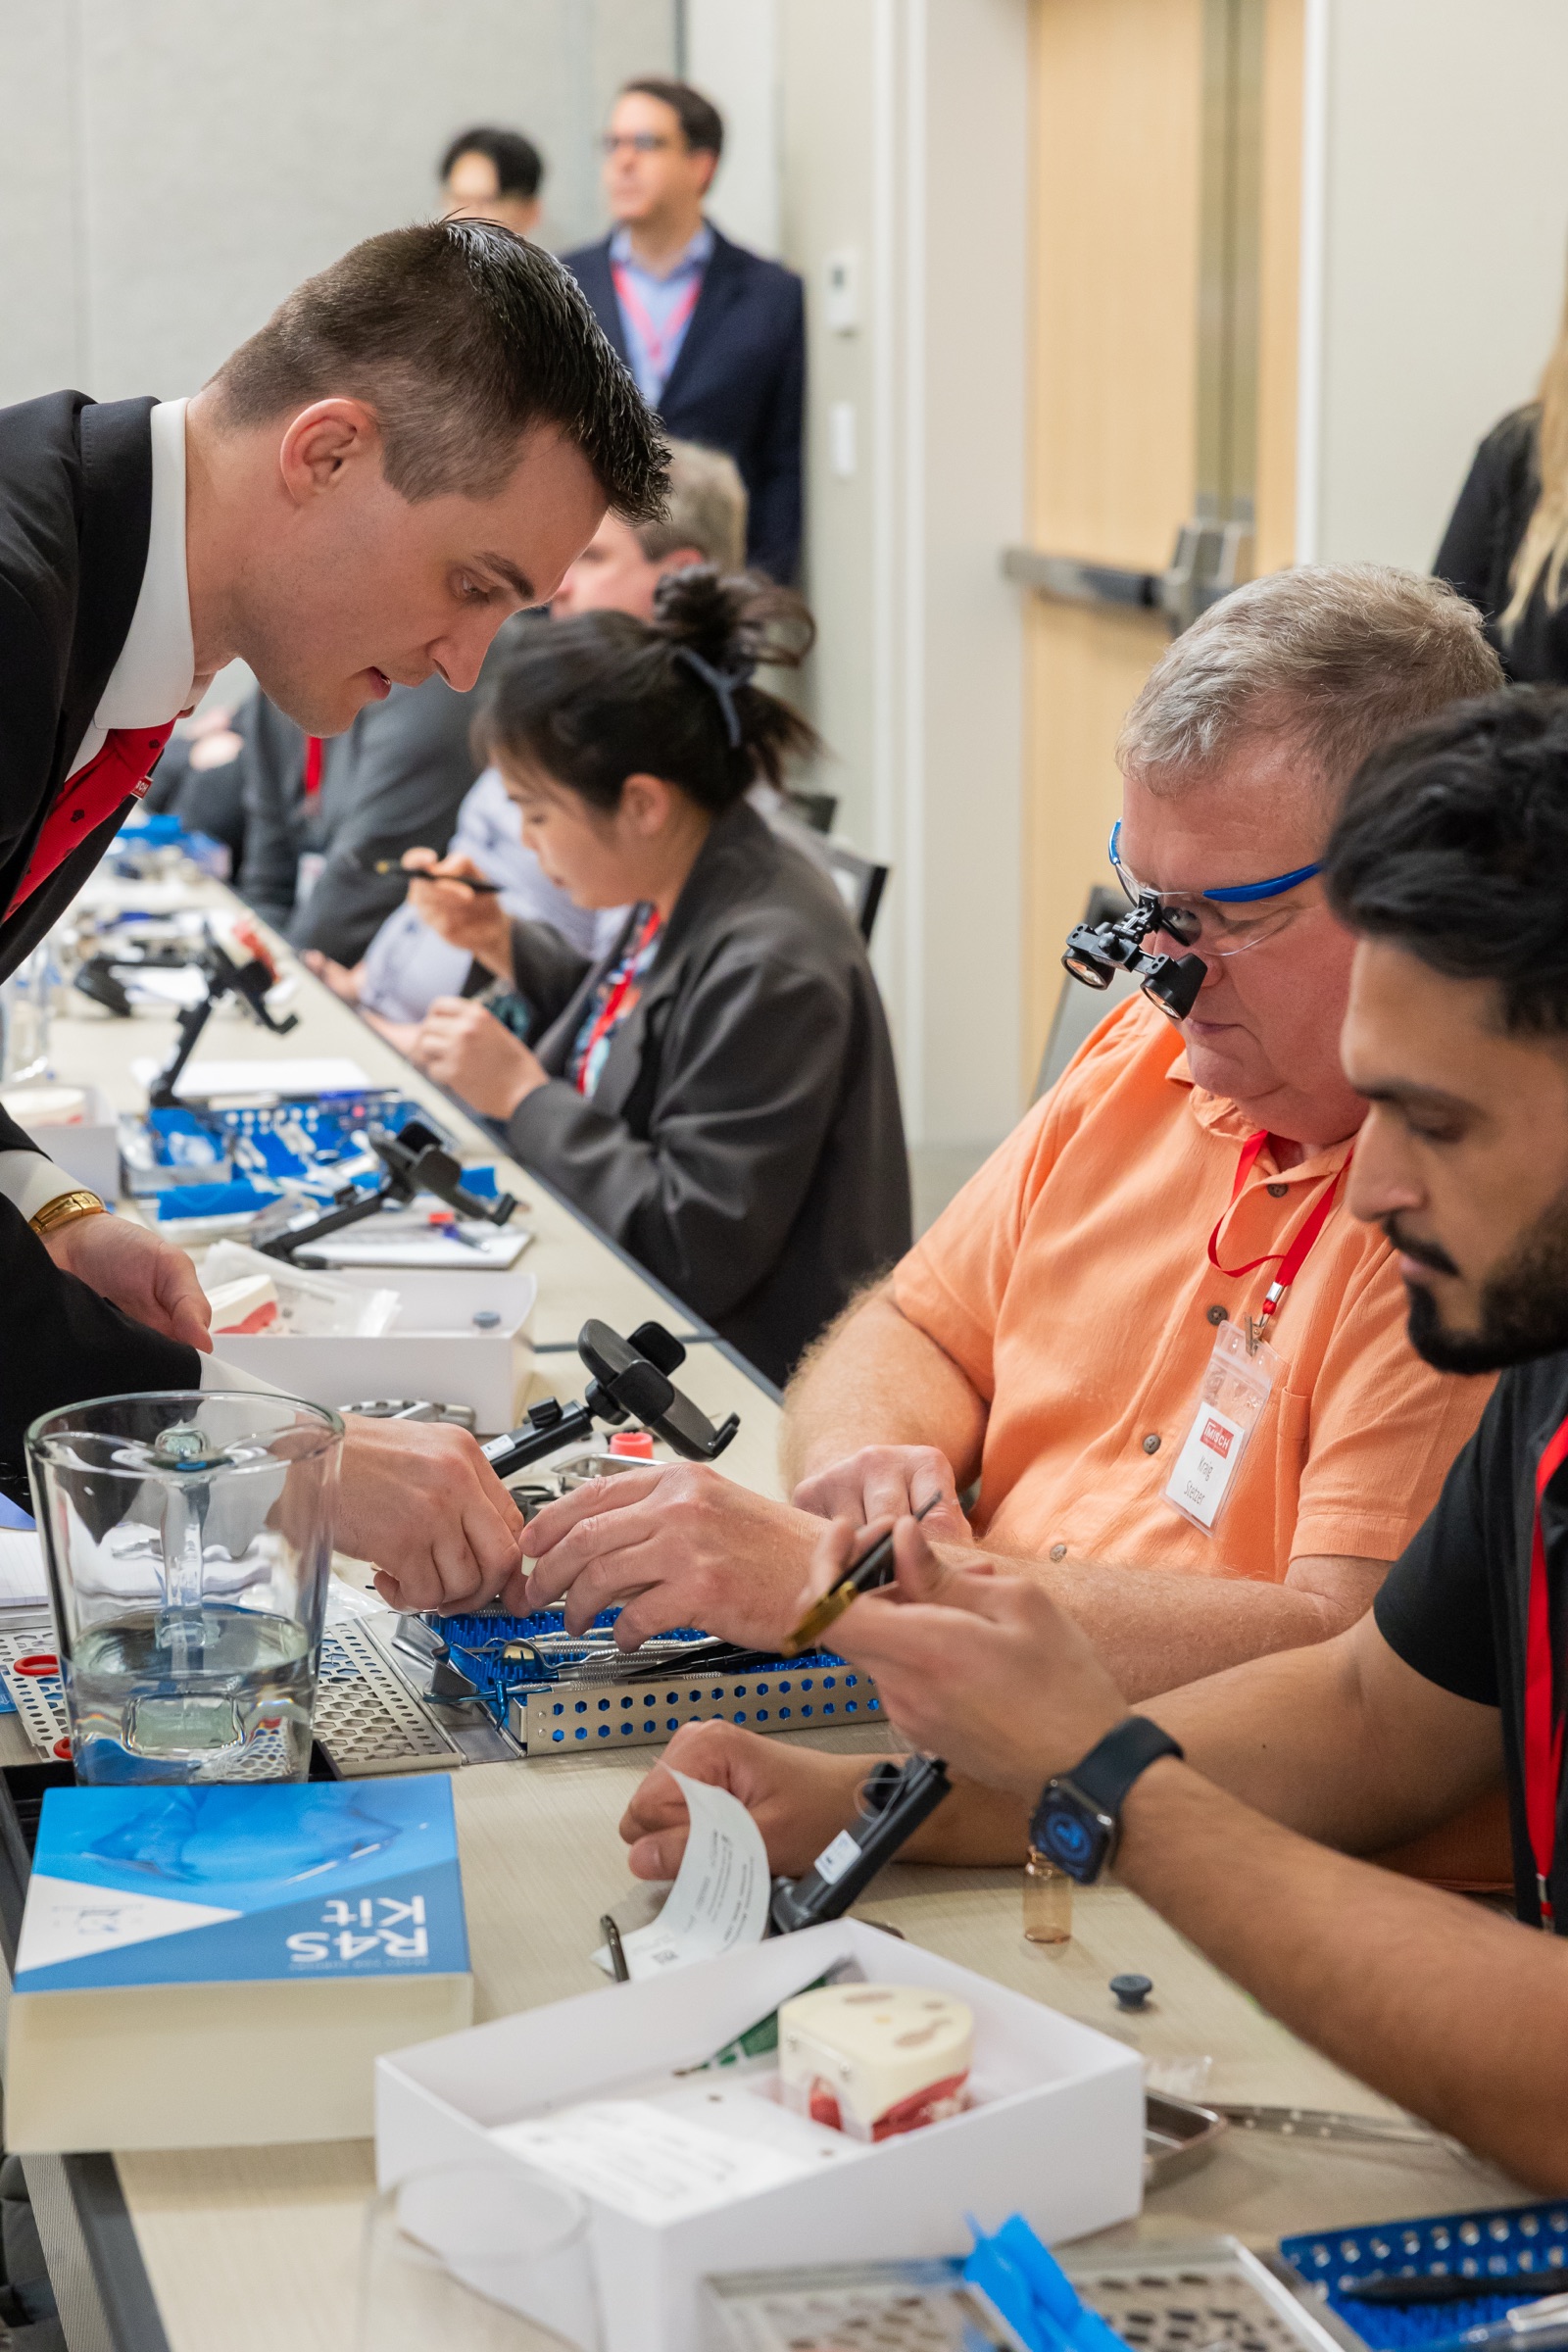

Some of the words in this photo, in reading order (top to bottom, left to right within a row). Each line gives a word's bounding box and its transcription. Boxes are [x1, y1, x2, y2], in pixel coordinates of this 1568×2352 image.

[1198, 1455, 1214, 1482] Kraig
[320, 1895, 426, 1928] Kit
[285, 1927, 428, 1963] R4S
